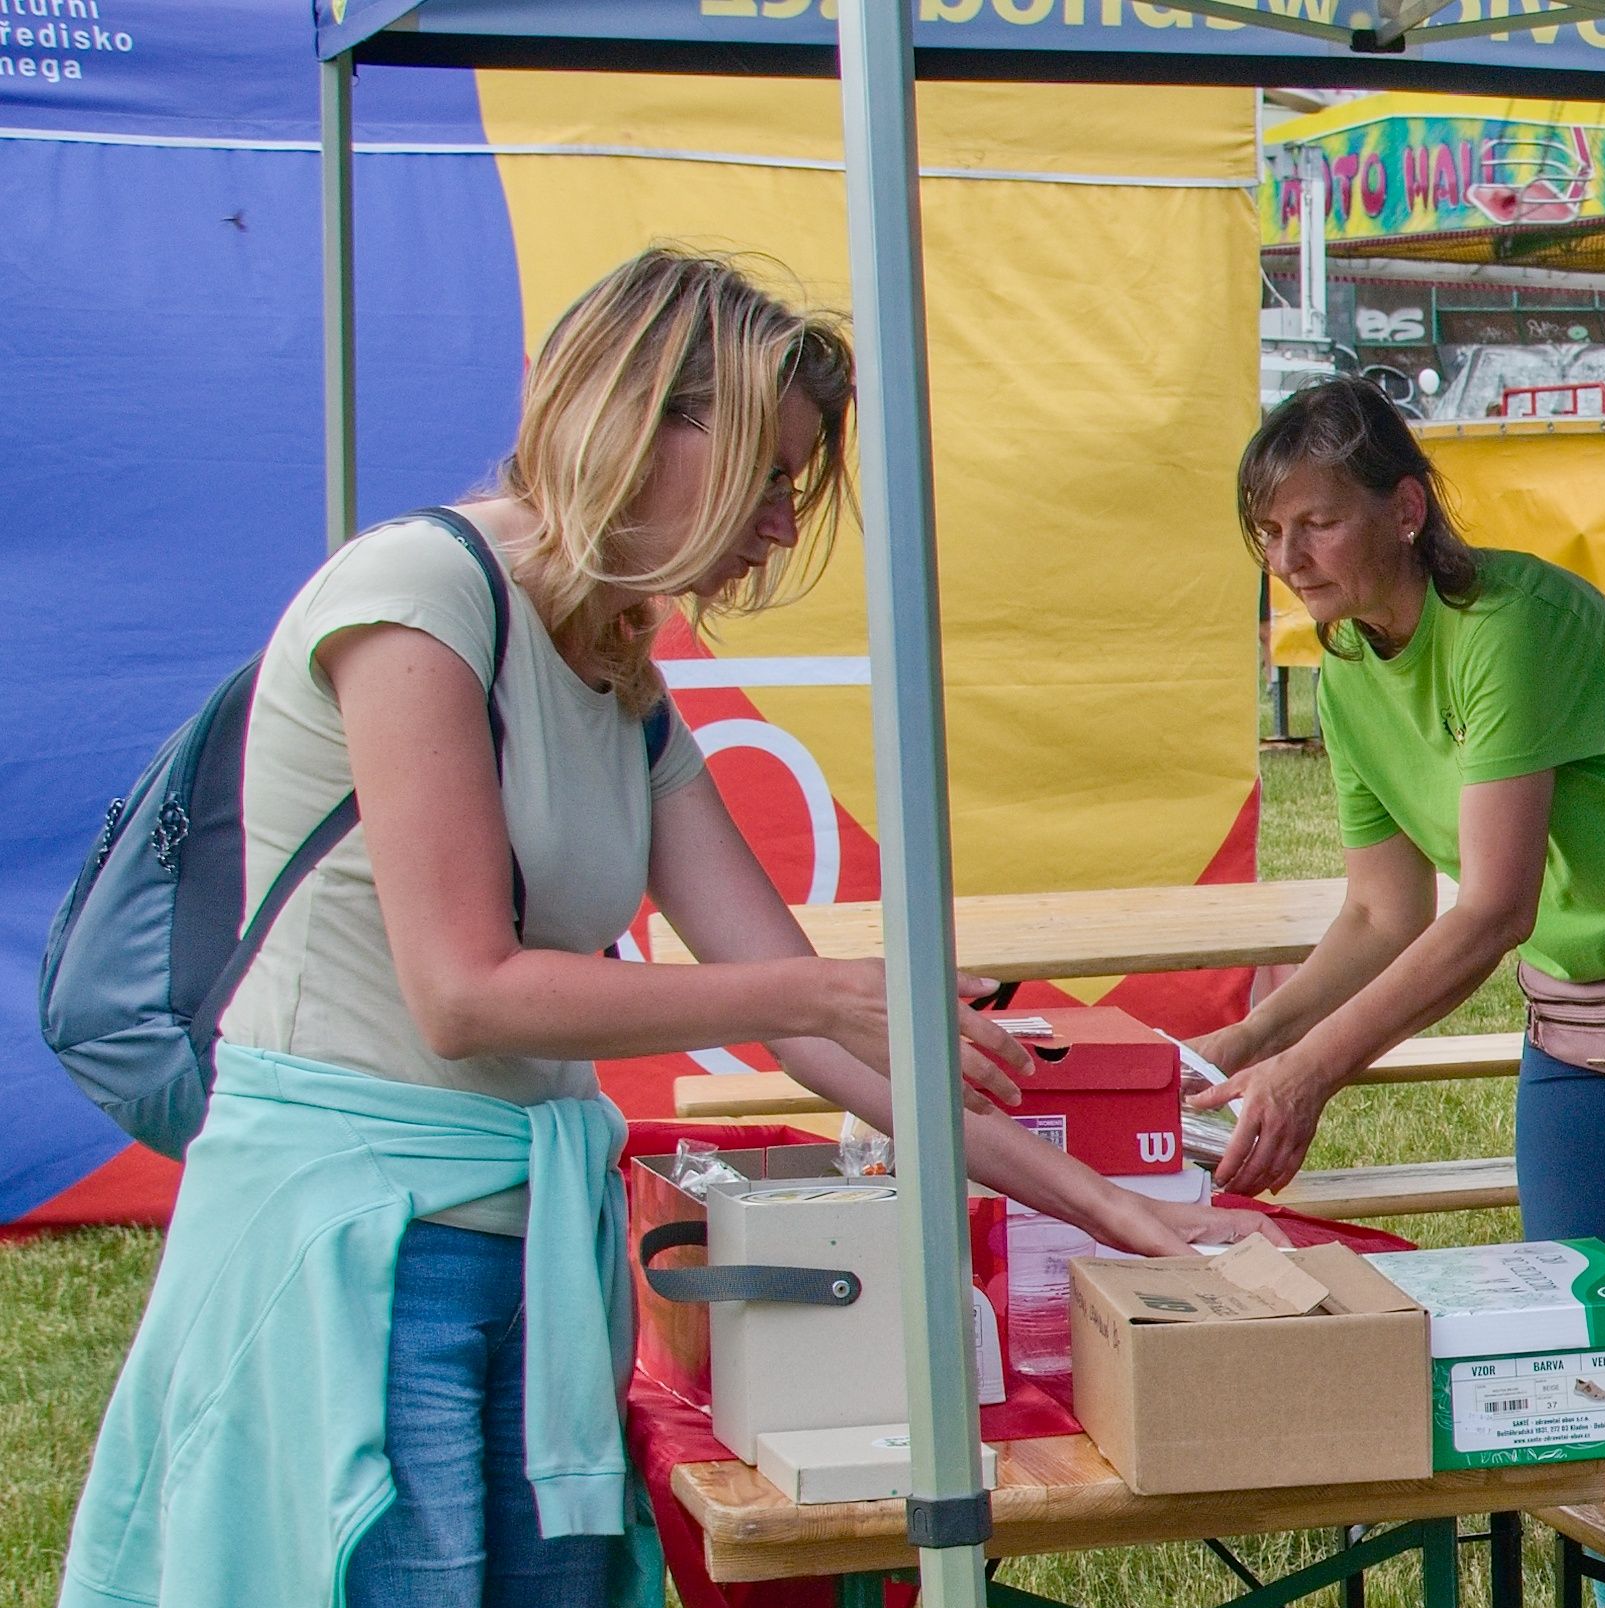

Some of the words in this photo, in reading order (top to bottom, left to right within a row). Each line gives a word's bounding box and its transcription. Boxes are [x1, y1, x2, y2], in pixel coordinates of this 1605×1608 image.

[1280, 151, 1388, 228] ATO
[1472, 1365, 1496, 1377] VZOR
[1533, 1360, 1564, 1372] BARVA
